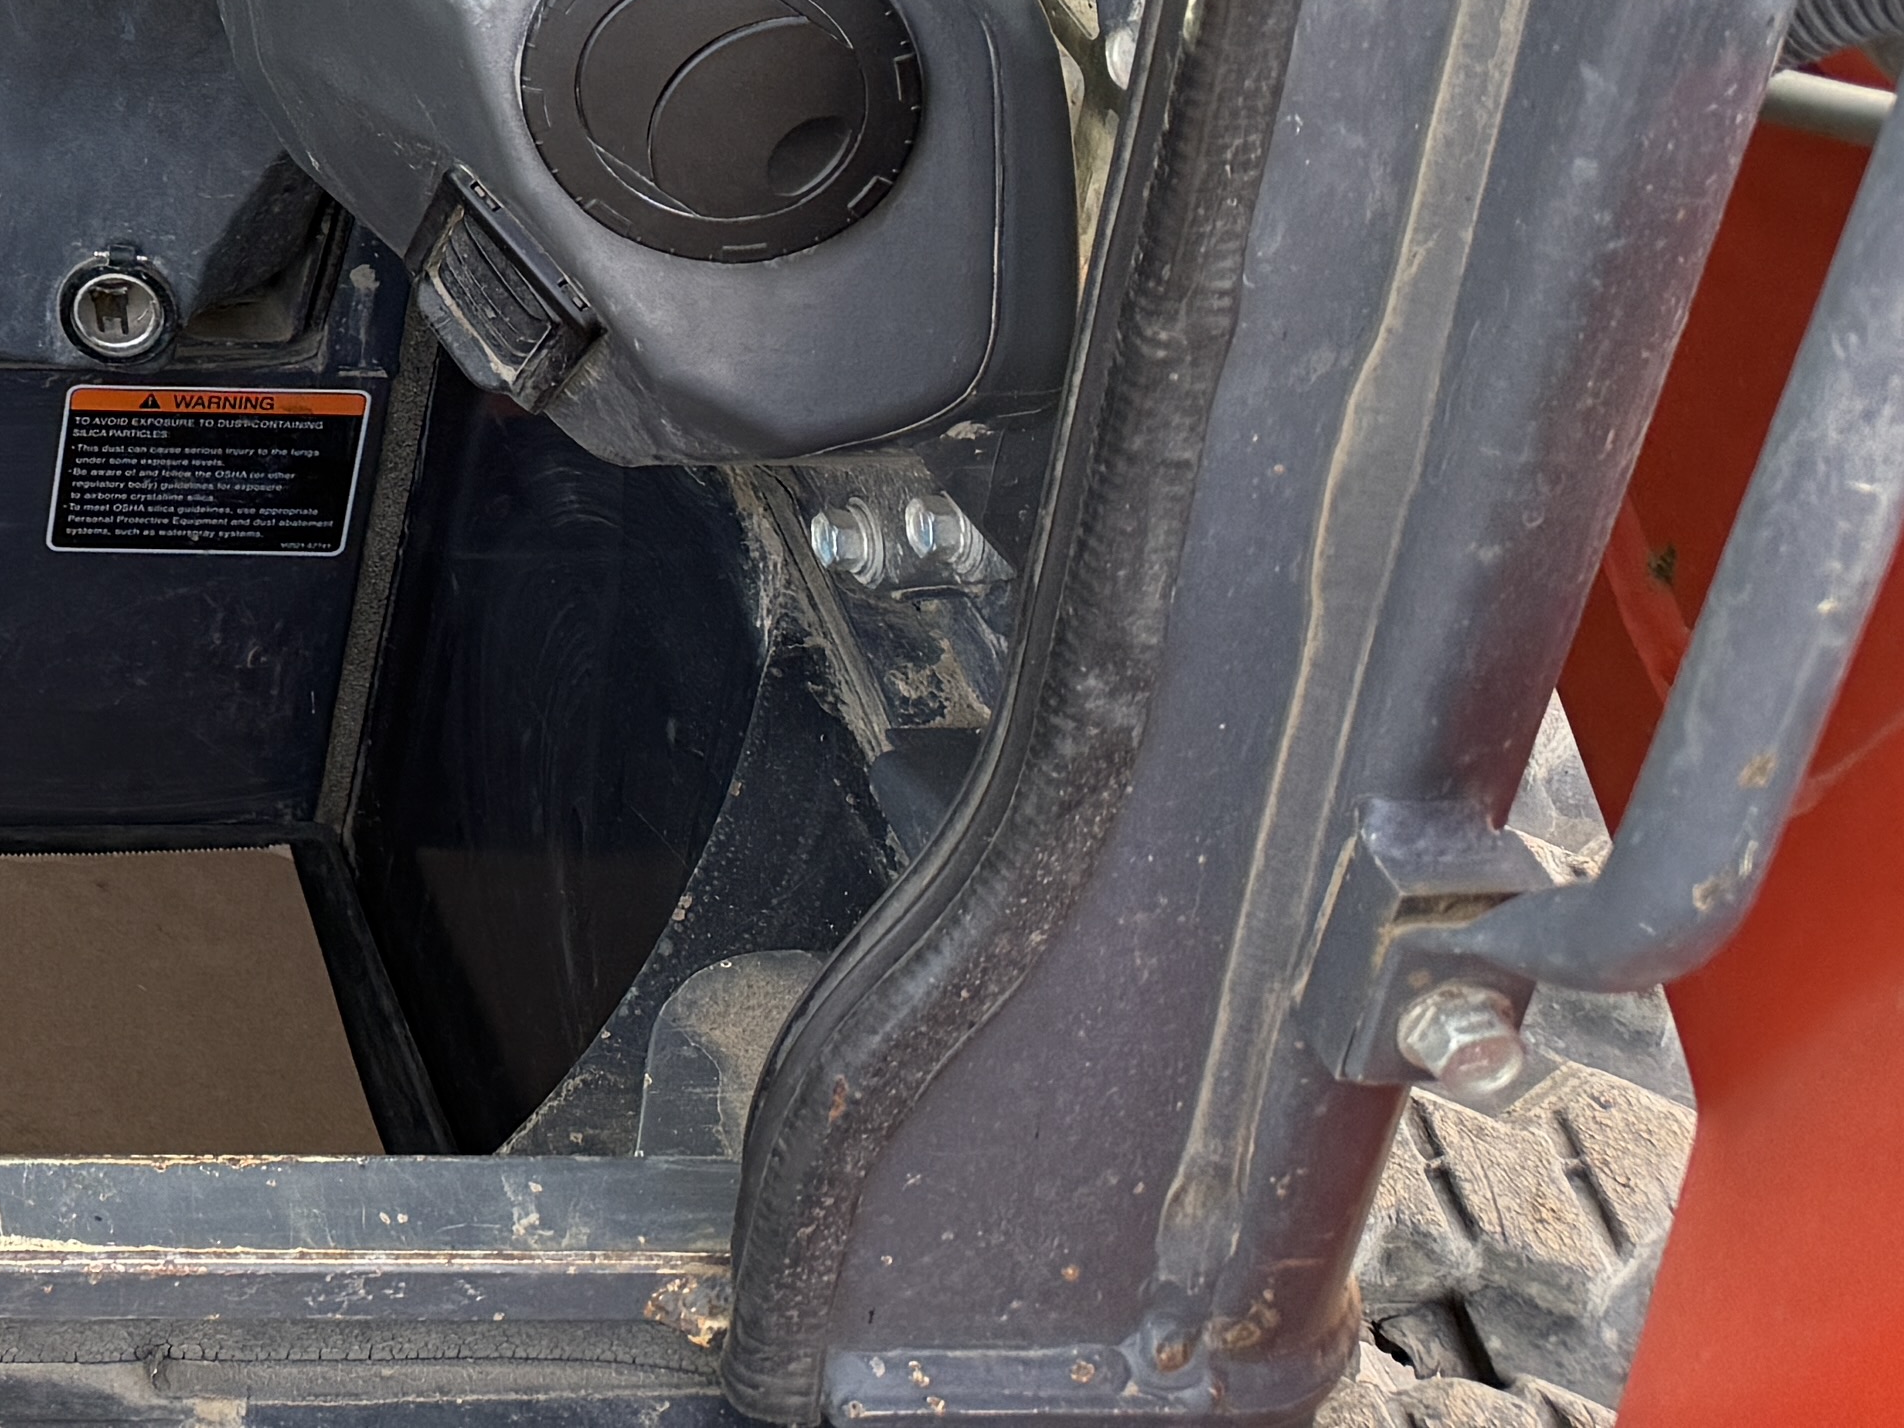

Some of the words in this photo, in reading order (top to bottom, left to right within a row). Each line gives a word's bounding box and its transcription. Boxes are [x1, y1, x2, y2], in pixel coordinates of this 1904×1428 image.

[171, 393, 276, 411] WARNING
[73, 416, 91, 425] TO
[91, 416, 129, 426] AVOID
[130, 417, 195, 427] EXPOSURE
[198, 418, 214, 427] TO
[71, 428, 107, 437] SILICA
[76, 443, 99, 452] This
[101, 444, 125, 452] dust
[183, 447, 223, 455] serious
[224, 447, 255, 456] injury
[270, 448, 288, 456] the
[289, 448, 320, 458] lungs
[74, 456, 106, 464] under
[139, 458, 188, 467] exposure
[214, 469, 247, 478] OSHA
[71, 480, 125, 489] regulatory
[68, 502, 81, 510] To
[112, 503, 145, 512] OSHA
[146, 504, 175, 512] silica
[258, 506, 319, 516] appropriate
[66, 514, 114, 523] Personal
[115, 515, 169, 524] Protective
[171, 516, 228, 526] Equipment
[252, 518, 275, 526] dust
[277, 518, 334, 527] abatement
[114, 527, 140, 535] such
